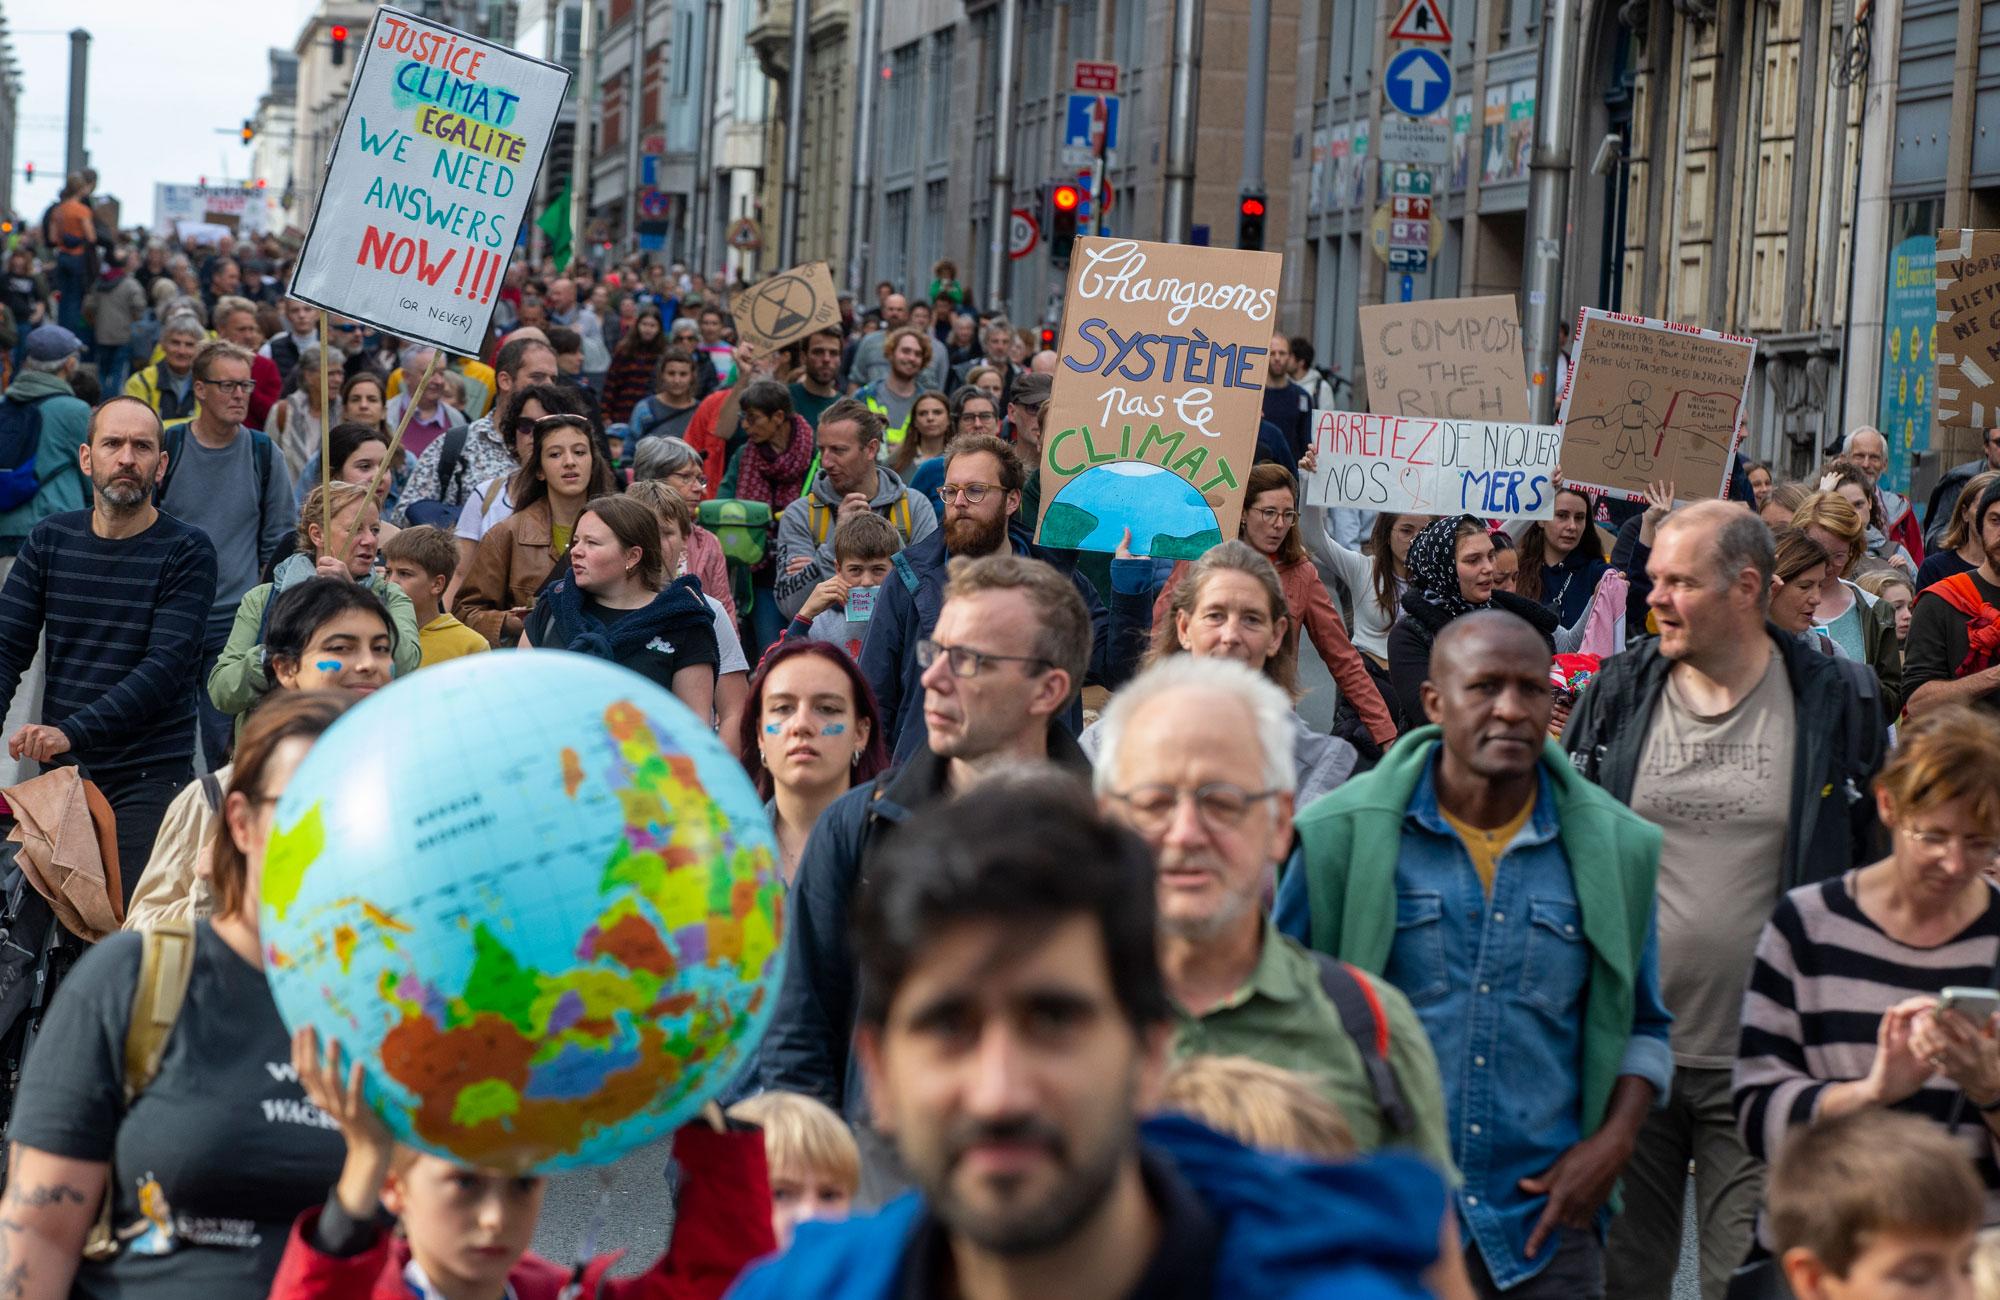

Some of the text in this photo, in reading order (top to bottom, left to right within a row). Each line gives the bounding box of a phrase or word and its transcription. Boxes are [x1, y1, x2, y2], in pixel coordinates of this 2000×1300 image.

[397, 62, 520, 124] CLIMAT
[360, 116, 514, 198] WE NEED
[364, 176, 506, 248] ANSWERS
[356, 224, 502, 305] NOW!!!
[1078, 241, 1276, 326] Changeons
[400, 297, 473, 334] (OR NEVER)
[1380, 316, 1518, 357] COMPOST
[1953, 317, 1981, 340] NE
[1062, 317, 1268, 391] SYSTÈME
[1417, 361, 1485, 386] THE
[1097, 386, 1221, 438] pas le
[1397, 386, 1503, 420] RICH
[1048, 423, 1240, 495] CLIMAT
[1315, 412, 1439, 466] ARRETEZ
[1441, 421, 1472, 468] DE
[1324, 462, 1390, 504] NOS
[1462, 469, 1548, 514] MERS
[1569, 483, 1609, 497] FRAGILE
